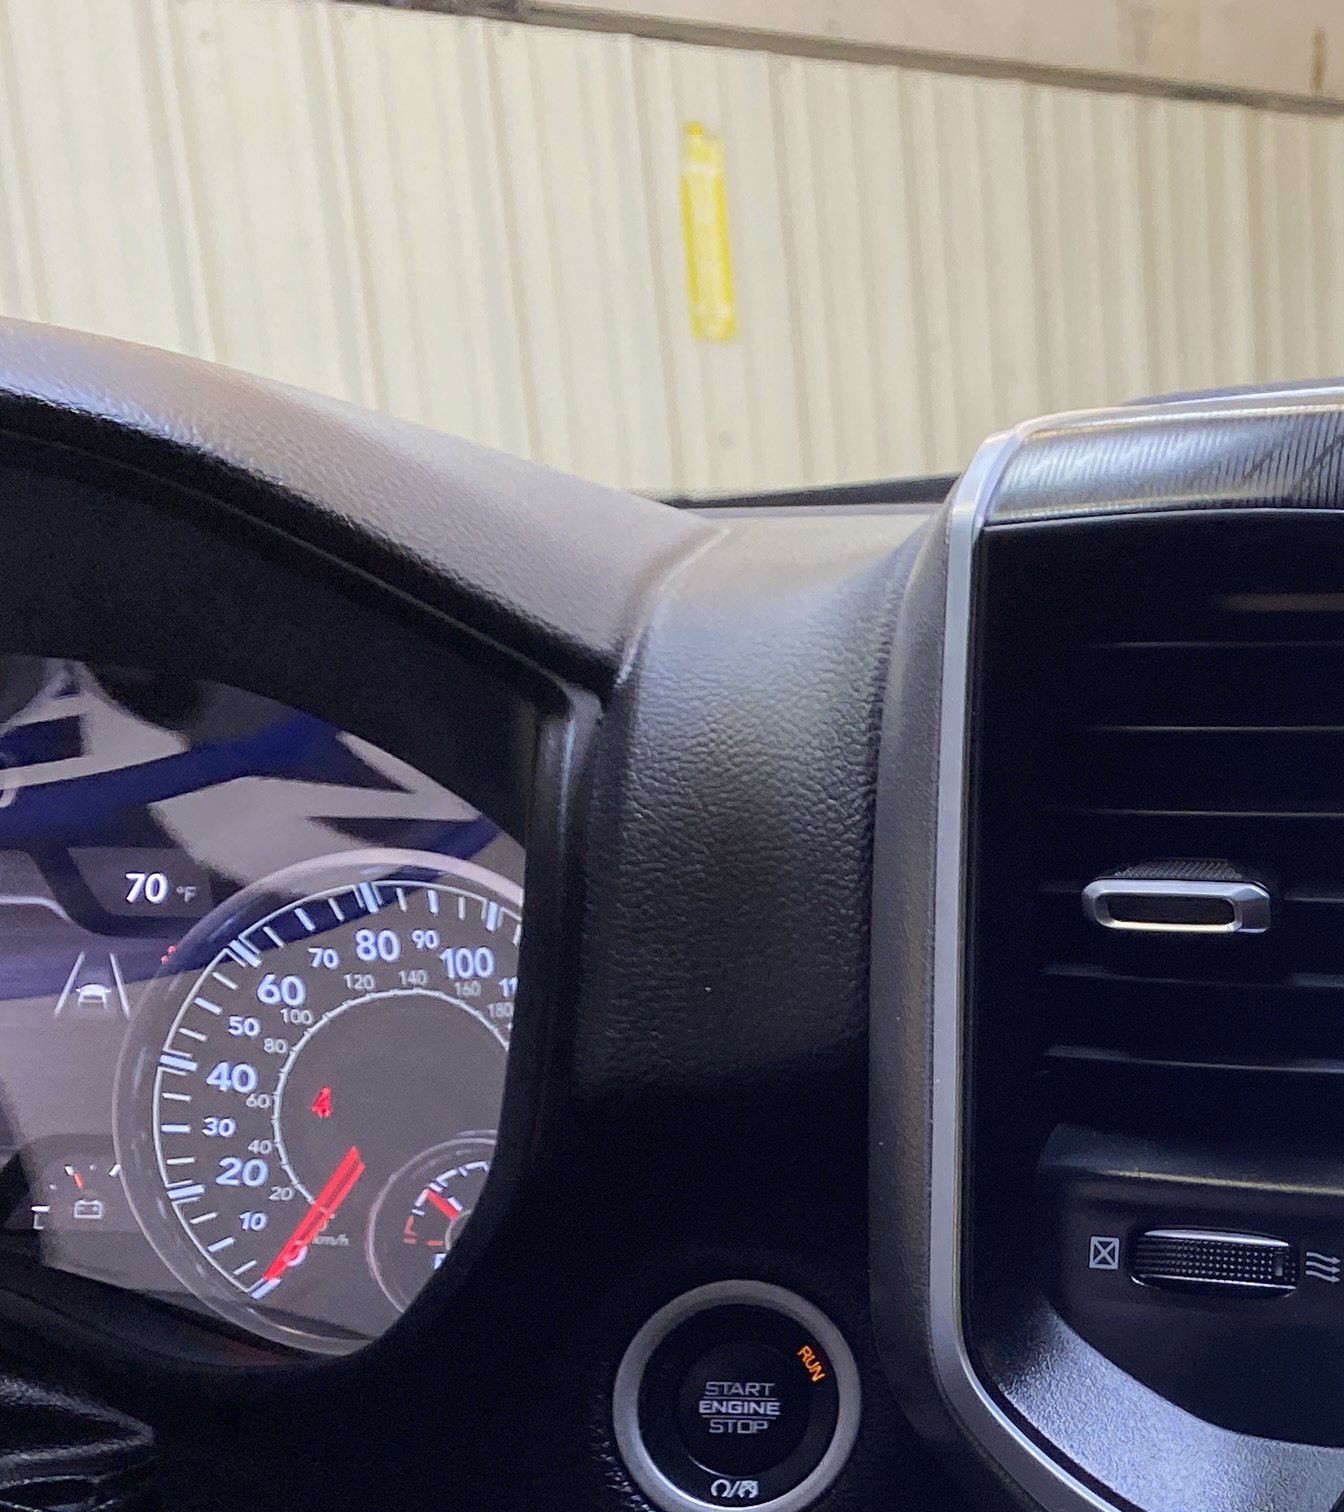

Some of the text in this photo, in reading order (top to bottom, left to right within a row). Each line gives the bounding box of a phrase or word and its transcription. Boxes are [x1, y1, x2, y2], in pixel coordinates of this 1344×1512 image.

[126, 873, 168, 904] 70
[355, 928, 400, 963] 80
[411, 929, 439, 949] 90
[308, 948, 339, 970] 70
[440, 947, 496, 979] 100
[344, 973, 376, 990] 120
[399, 970, 428, 985] 140
[499, 977, 518, 998] 11
[257, 973, 306, 1008] 60
[454, 981, 481, 996] 160
[228, 1016, 261, 1037] 50
[280, 1008, 314, 1025] 100
[264, 1038, 287, 1054] 80
[206, 1062, 258, 1094] 40
[246, 1094, 271, 1109] 60
[202, 1116, 237, 1138] 30
[248, 1140, 273, 1155] 40
[215, 1157, 269, 1187] 20
[268, 1187, 294, 1201] 20
[239, 1211, 268, 1232] 10
[797, 1346, 825, 1383] RUN
[705, 1382, 776, 1396] START
[699, 1400, 780, 1415] ENGINE
[709, 1419, 769, 1434] STOP
